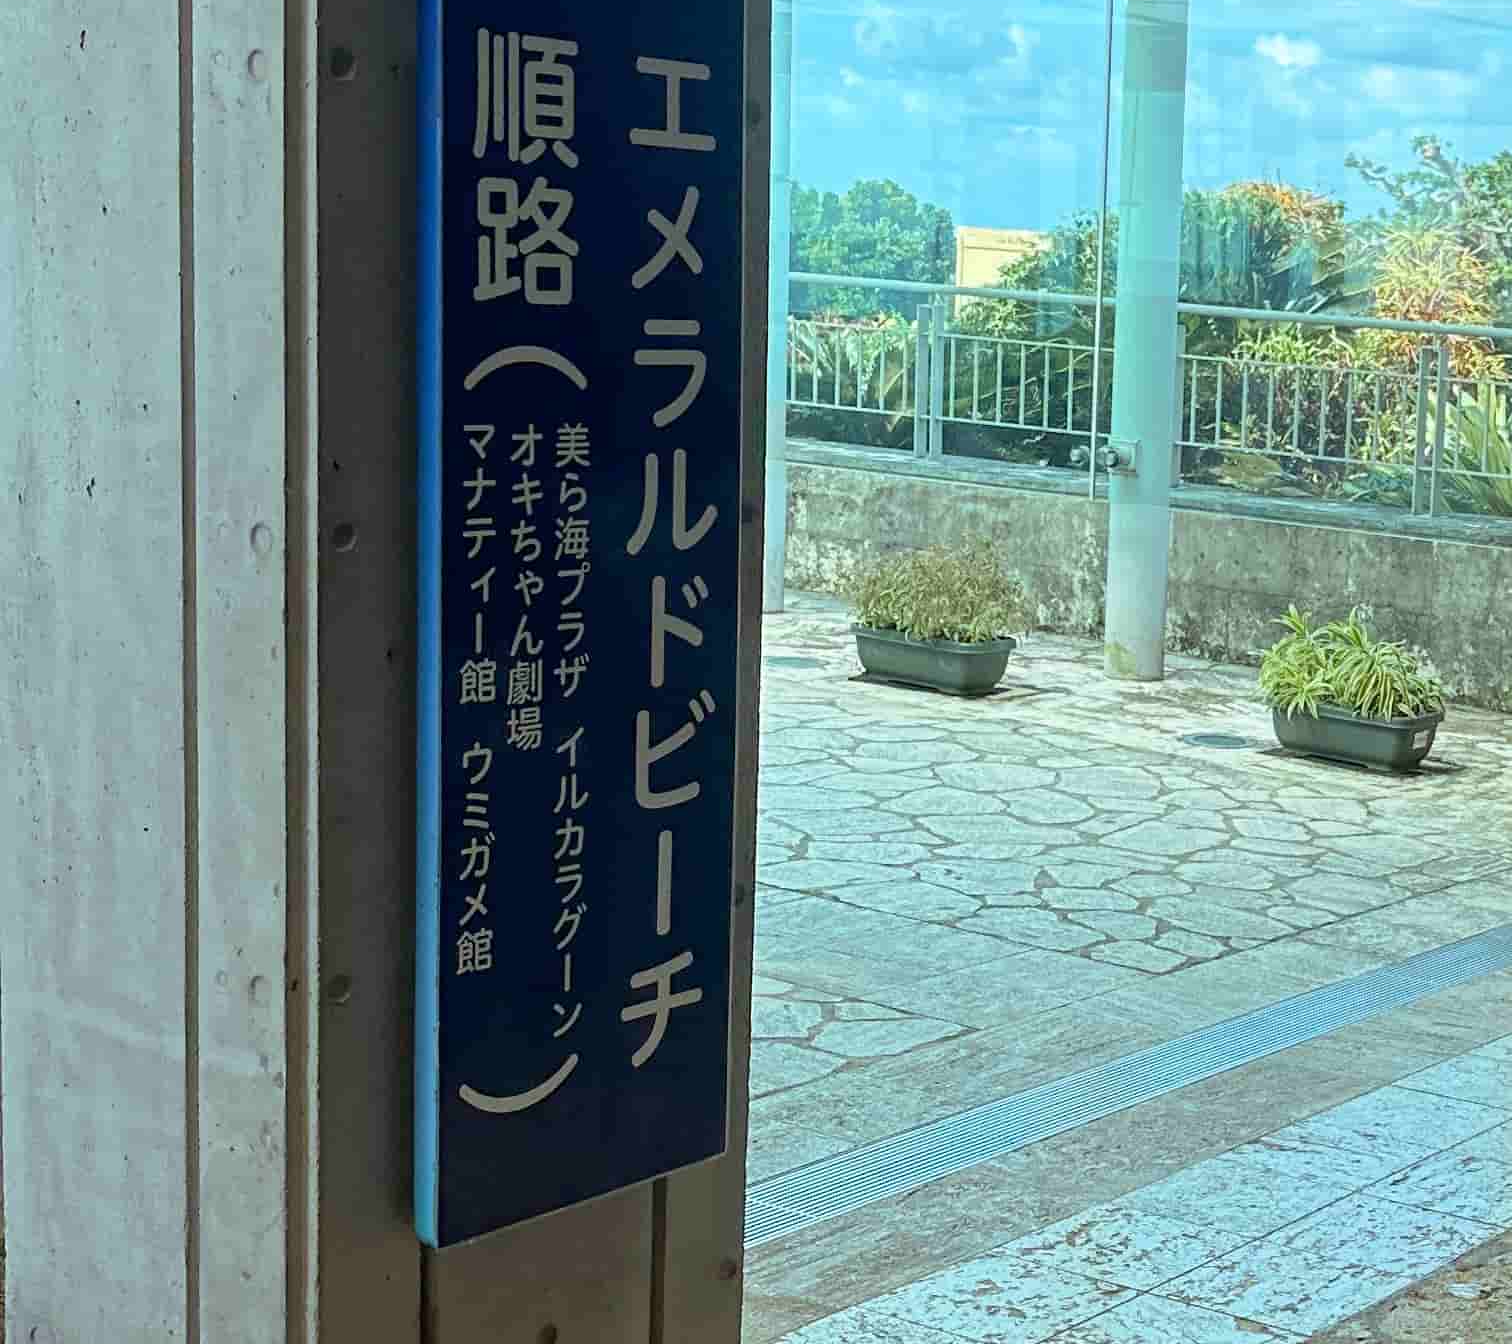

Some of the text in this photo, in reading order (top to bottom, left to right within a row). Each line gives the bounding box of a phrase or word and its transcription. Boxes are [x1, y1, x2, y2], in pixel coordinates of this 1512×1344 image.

[506, 423, 545, 752] オキちゃん劇場
[552, 422, 592, 1039] 美ら海プラザ イルカラグーン
[621, 56, 719, 1068] エメラルドビーチ
[456, 741, 496, 977] ウミガメ館
